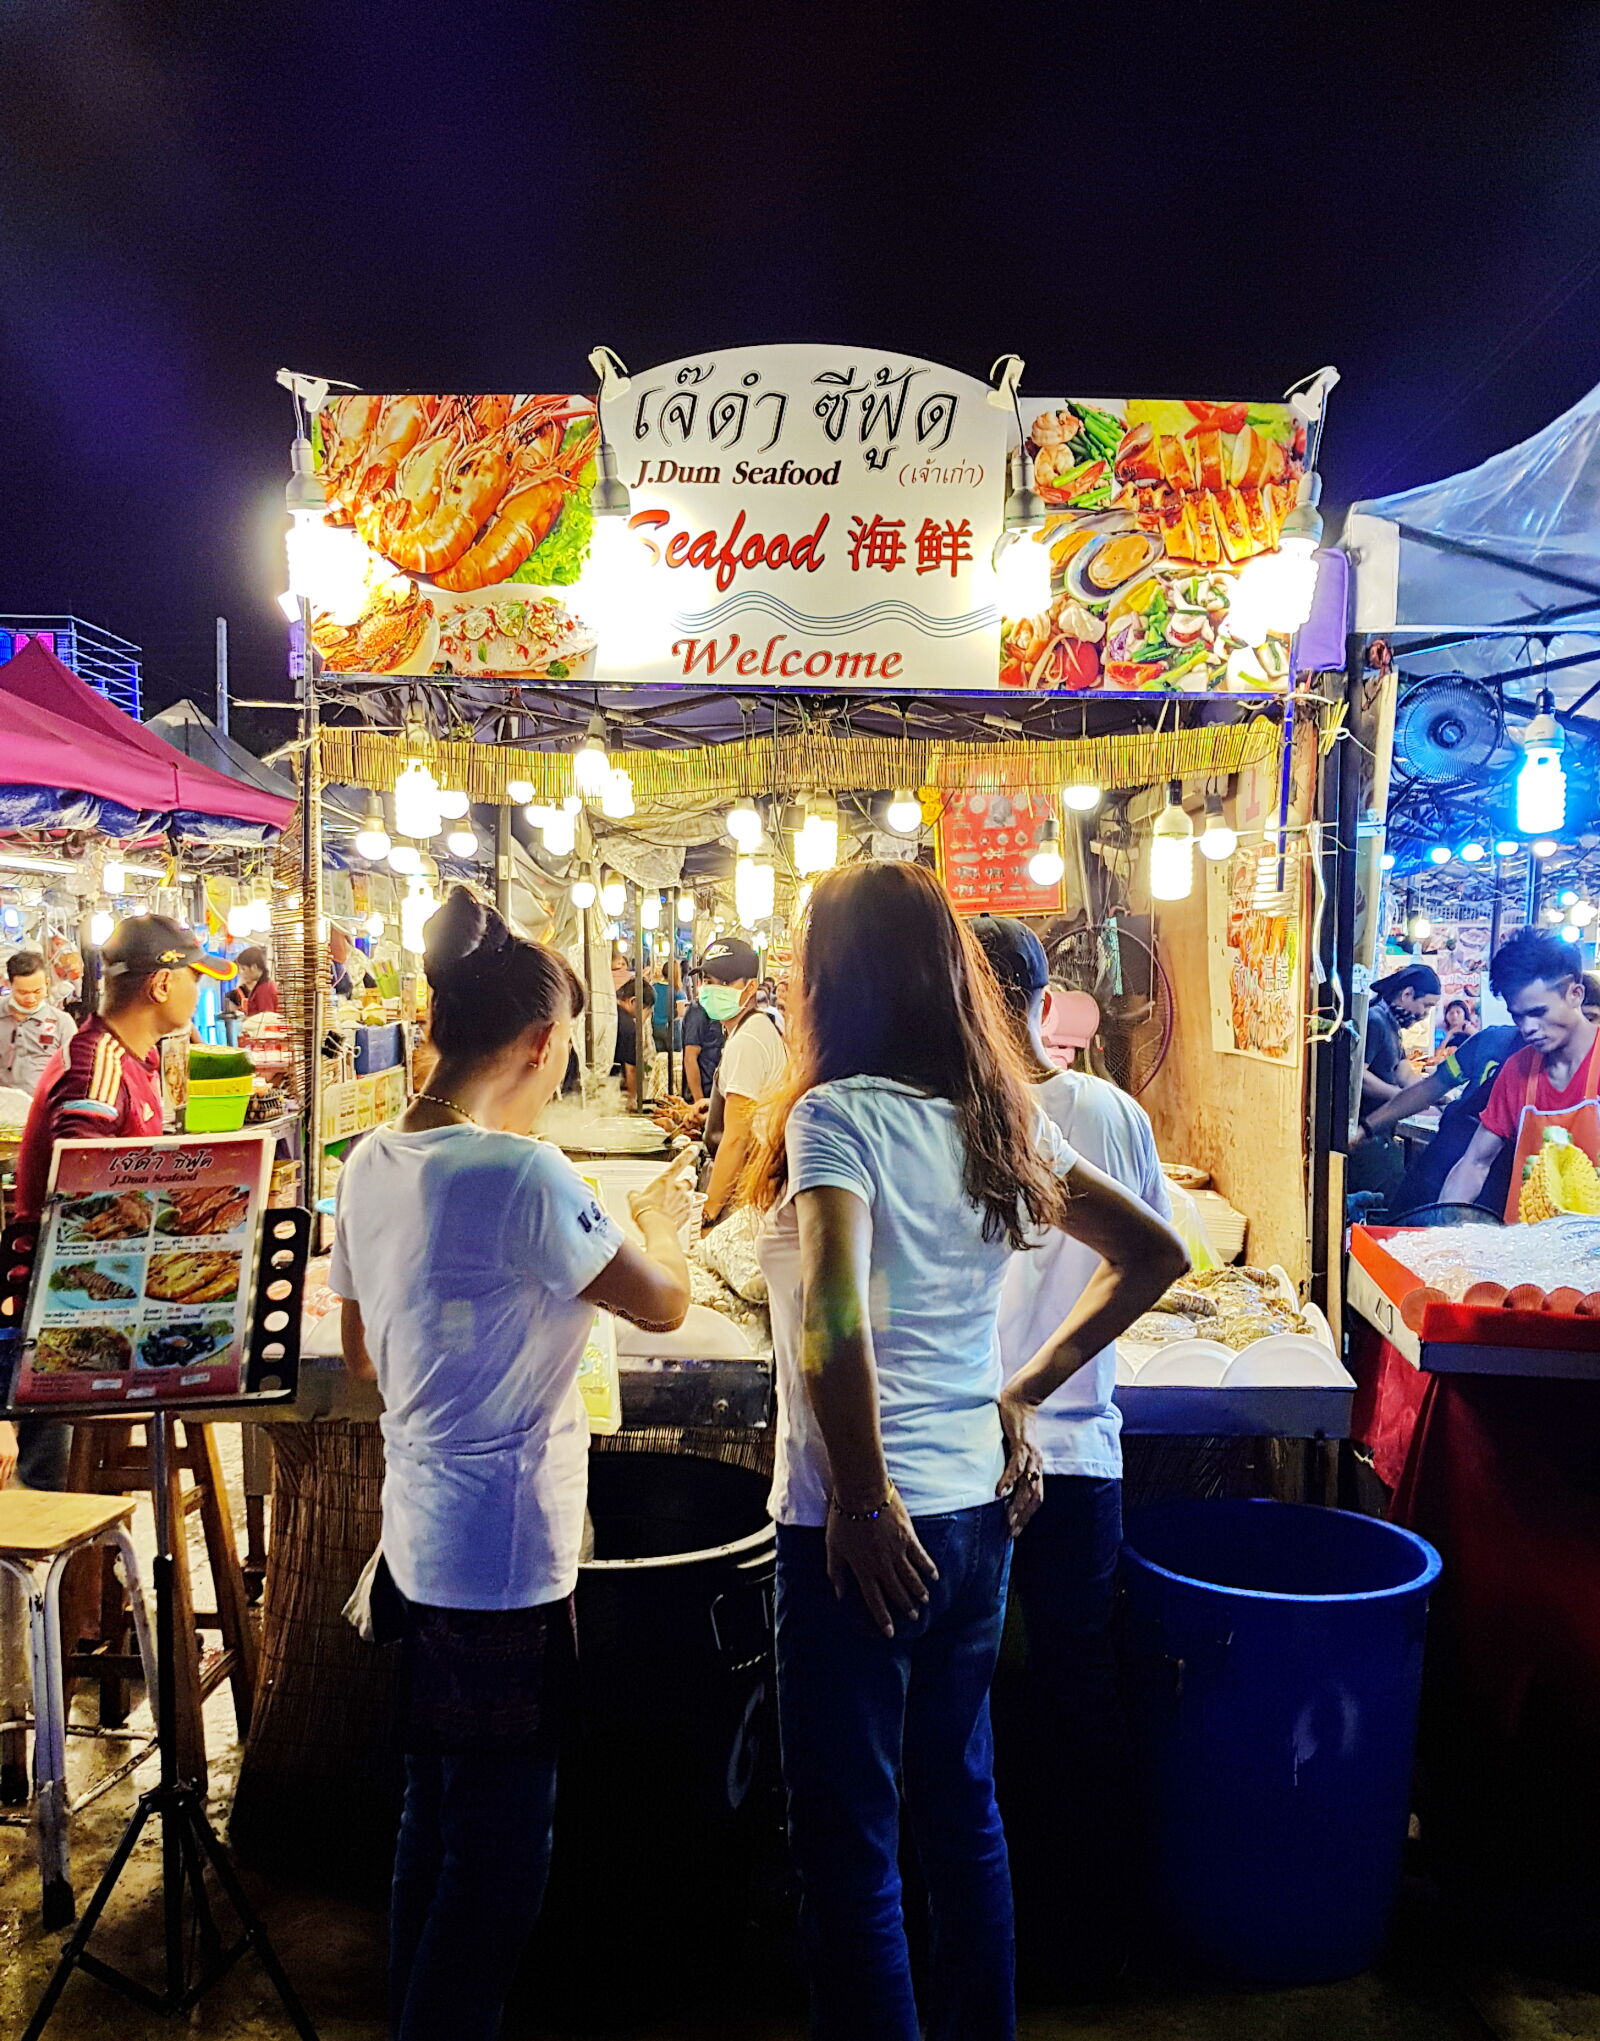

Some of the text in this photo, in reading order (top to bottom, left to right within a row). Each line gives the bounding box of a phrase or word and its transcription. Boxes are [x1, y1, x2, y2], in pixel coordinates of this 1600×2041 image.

[634, 364, 959, 471] เจ๊ดำ ซีฟู้ด
[631, 459, 842, 489] J.Dum Seafood
[898, 458, 984, 488] (เจ้าเก่า)
[847, 514, 973, 577] 海鲜
[671, 634, 903, 678] Welcome
[153, 1173, 198, 1183] Seafood
